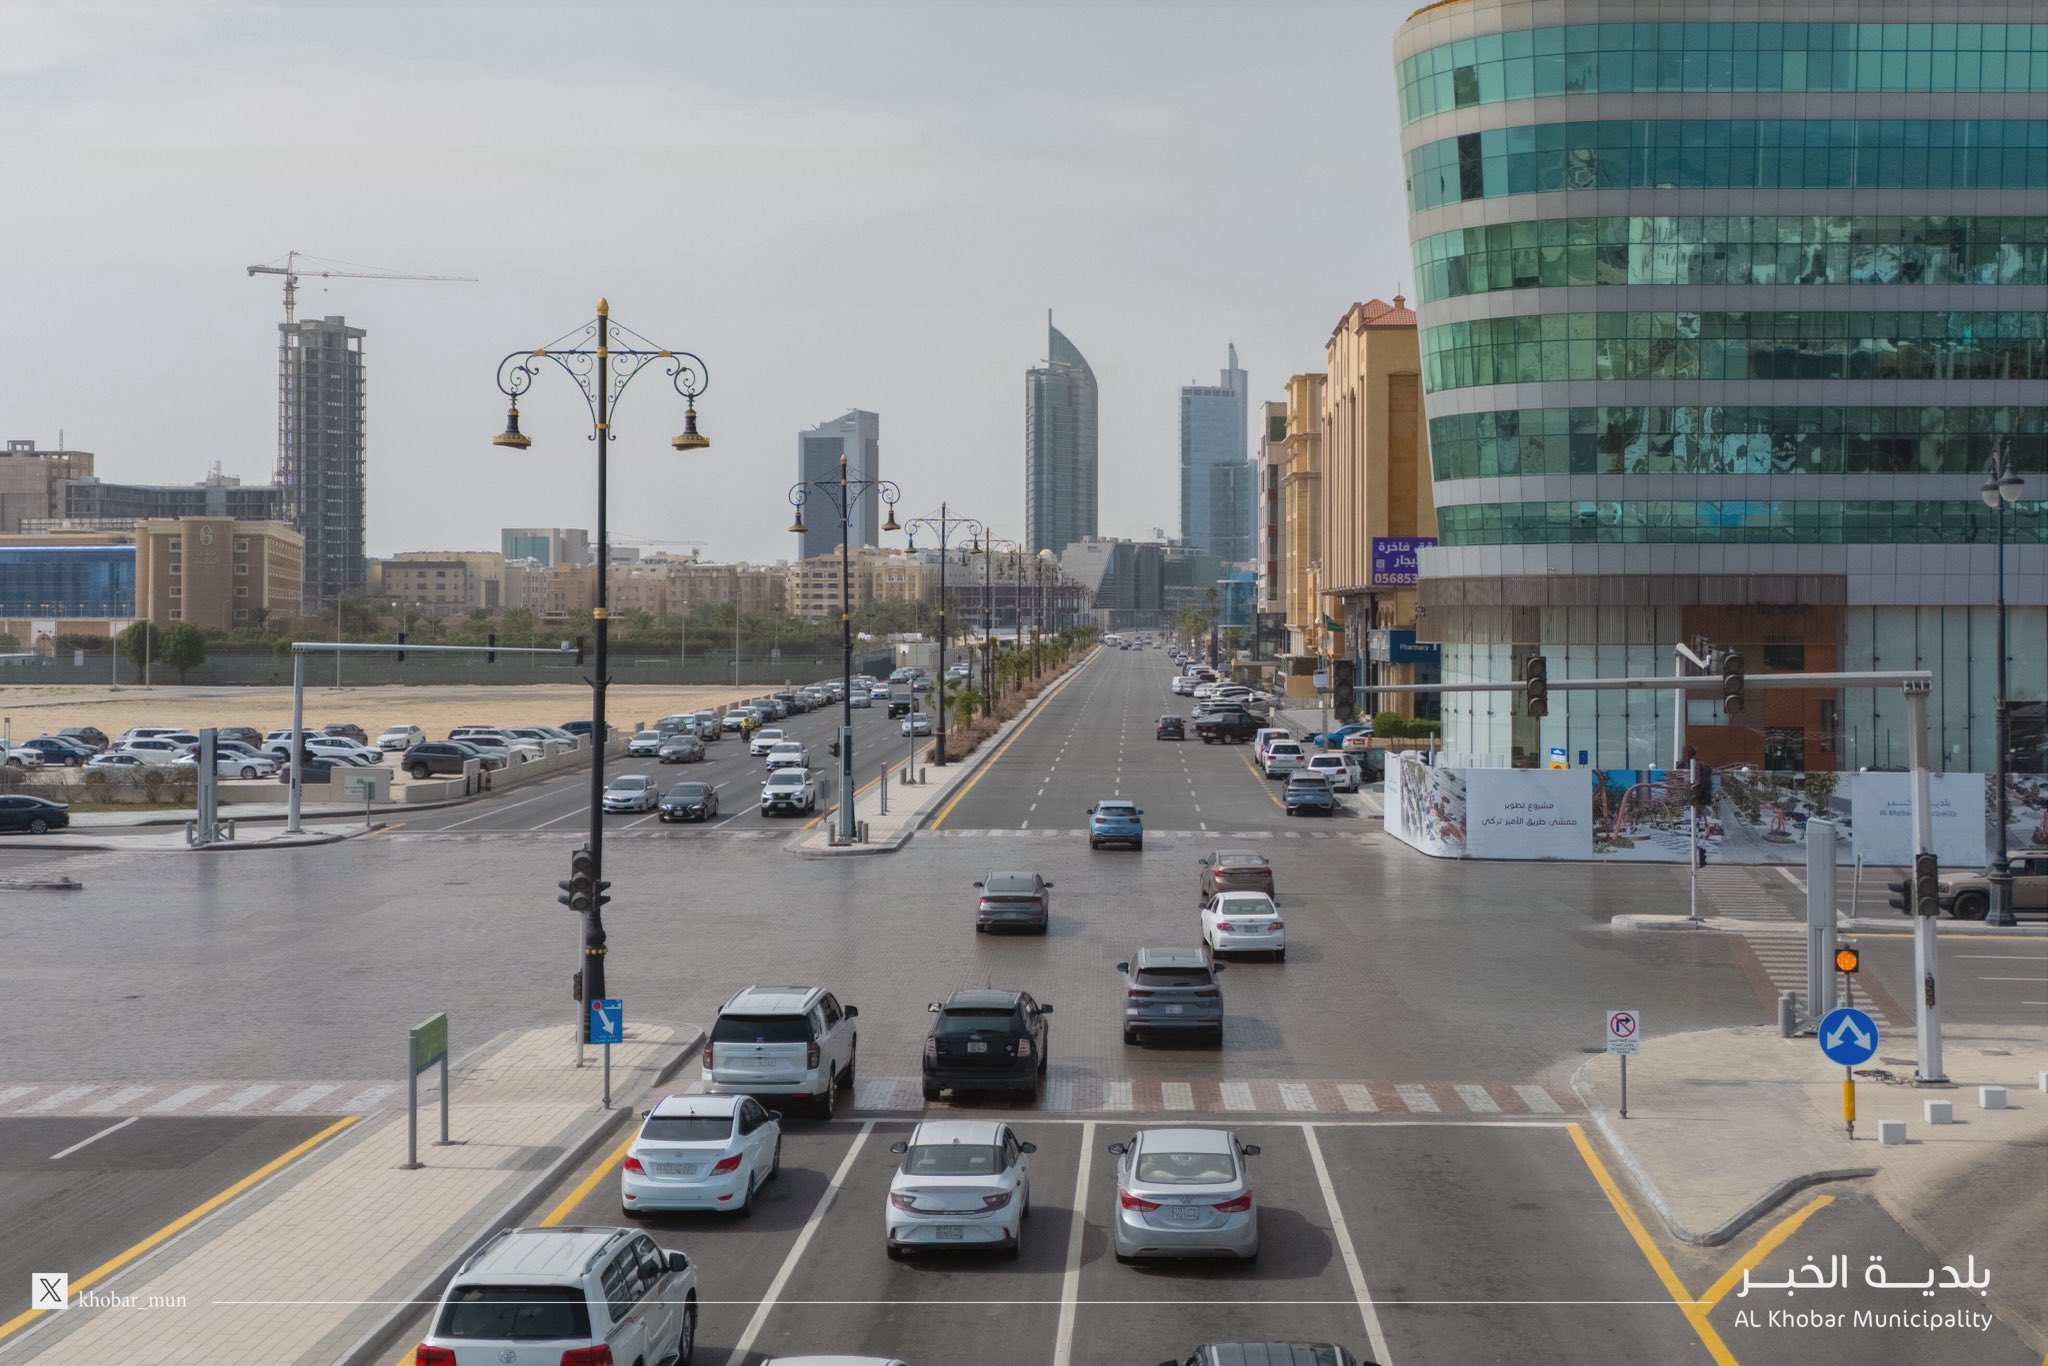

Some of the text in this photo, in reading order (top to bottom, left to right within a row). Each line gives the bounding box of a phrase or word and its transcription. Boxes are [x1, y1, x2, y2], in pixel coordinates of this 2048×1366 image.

[1378, 541, 1410, 554] فاخرة
[1393, 555, 1418, 567] يجار
[1374, 573, 1418, 584] 056853
[1399, 643, 1430, 652] Pharmacy
[1504, 802, 1554, 812] مشروع تطوير
[1930, 799, 1950, 808] بلدي
[1505, 817, 1523, 826] الأمير
[1526, 817, 1546, 827] طريق
